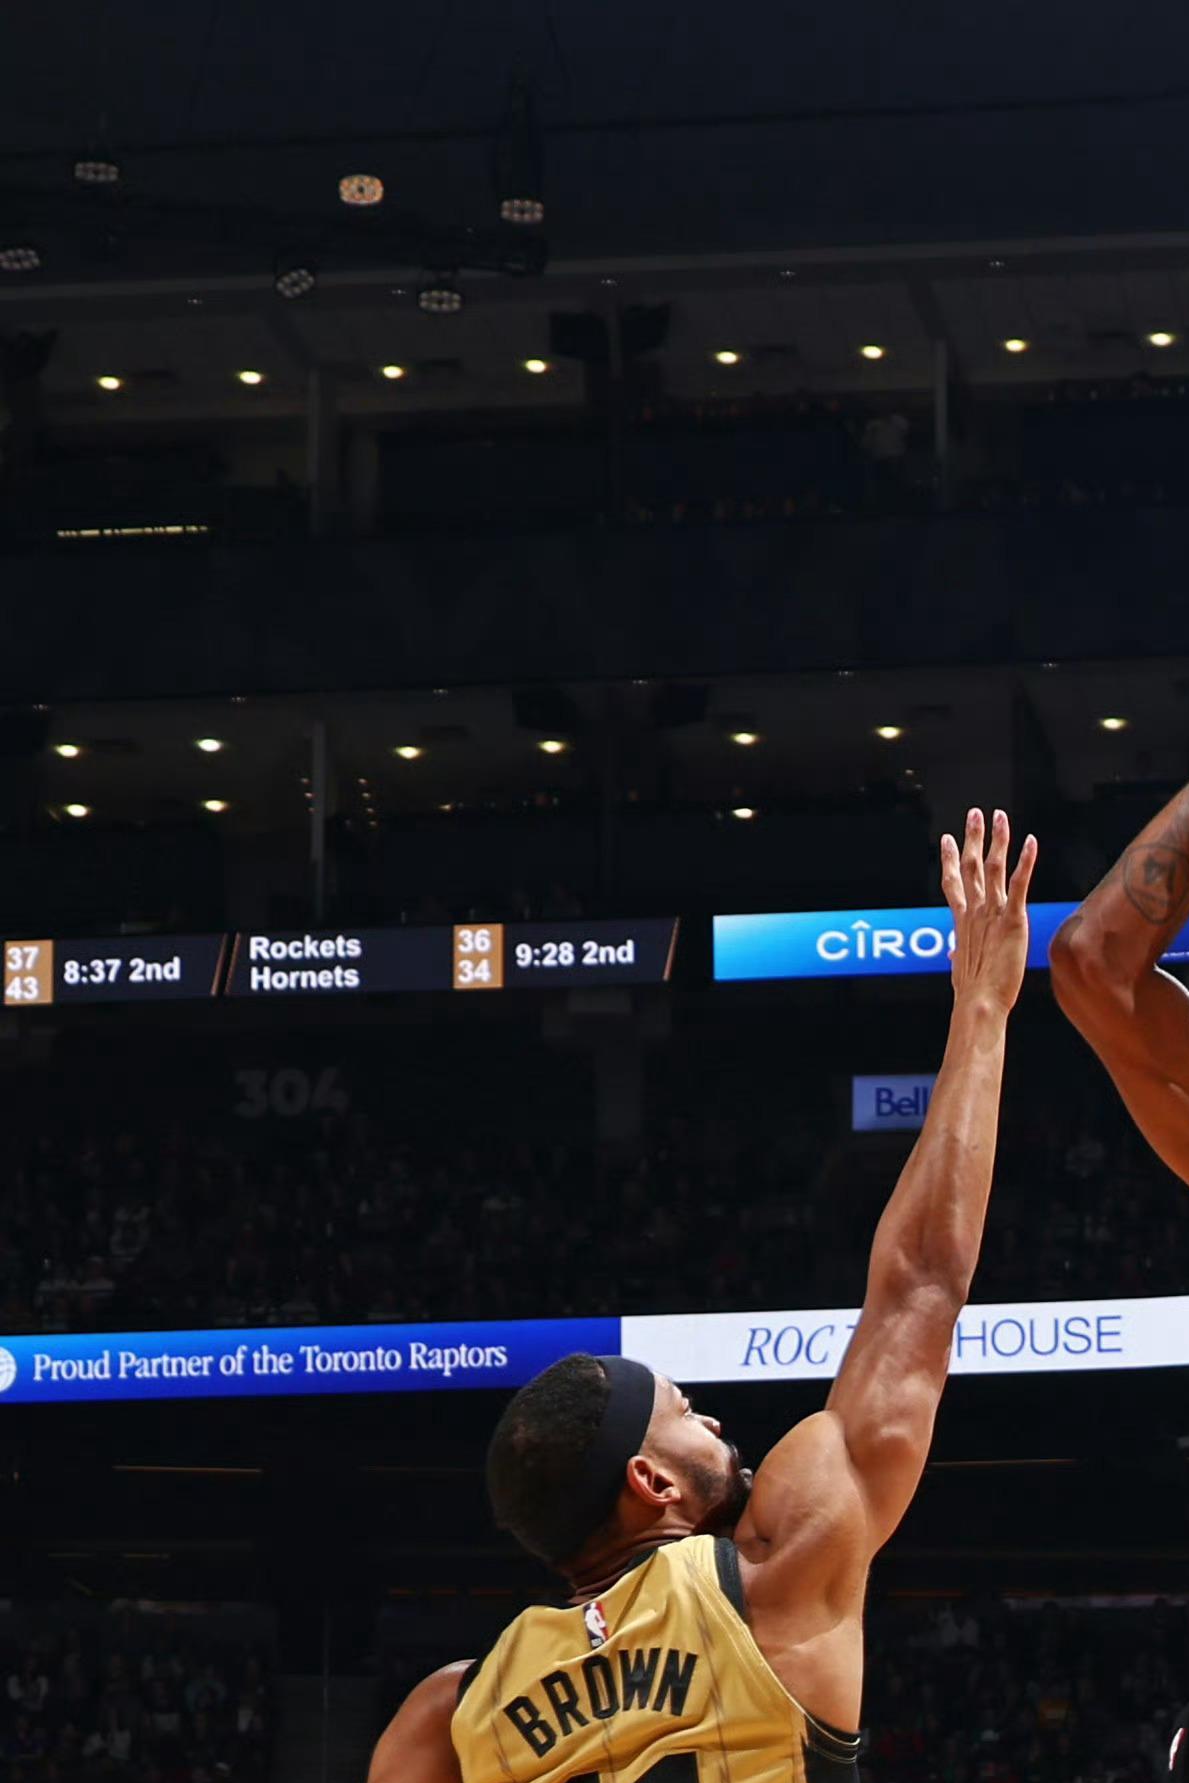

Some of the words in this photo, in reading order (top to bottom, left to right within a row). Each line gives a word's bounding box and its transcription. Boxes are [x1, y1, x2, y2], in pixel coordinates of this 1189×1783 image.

[250, 934, 362, 960] Rockets
[457, 928, 492, 953] 36
[515, 942, 575, 967] 9:28
[581, 939, 635, 965] 2nd
[816, 919, 956, 961] CÎRO
[6, 946, 40, 971] 37
[63, 959, 121, 984] 8:37
[128, 956, 181, 982] 2nd
[457, 959, 492, 983] 34
[5, 976, 39, 1001] 43
[250, 964, 361, 990] Hornets
[232, 1067, 350, 1119] 304
[876, 1086, 929, 1117] Bell
[956, 1315, 1123, 1359] HOUSE
[33, 1351, 111, 1381] Proud
[118, 1349, 212, 1379] Partner
[219, 1345, 247, 1376] of
[252, 1345, 293, 1374] the
[300, 1344, 401, 1374] Toronto
[408, 1342, 507, 1377] Raptors
[503, 1647, 698, 1758] BROWN
